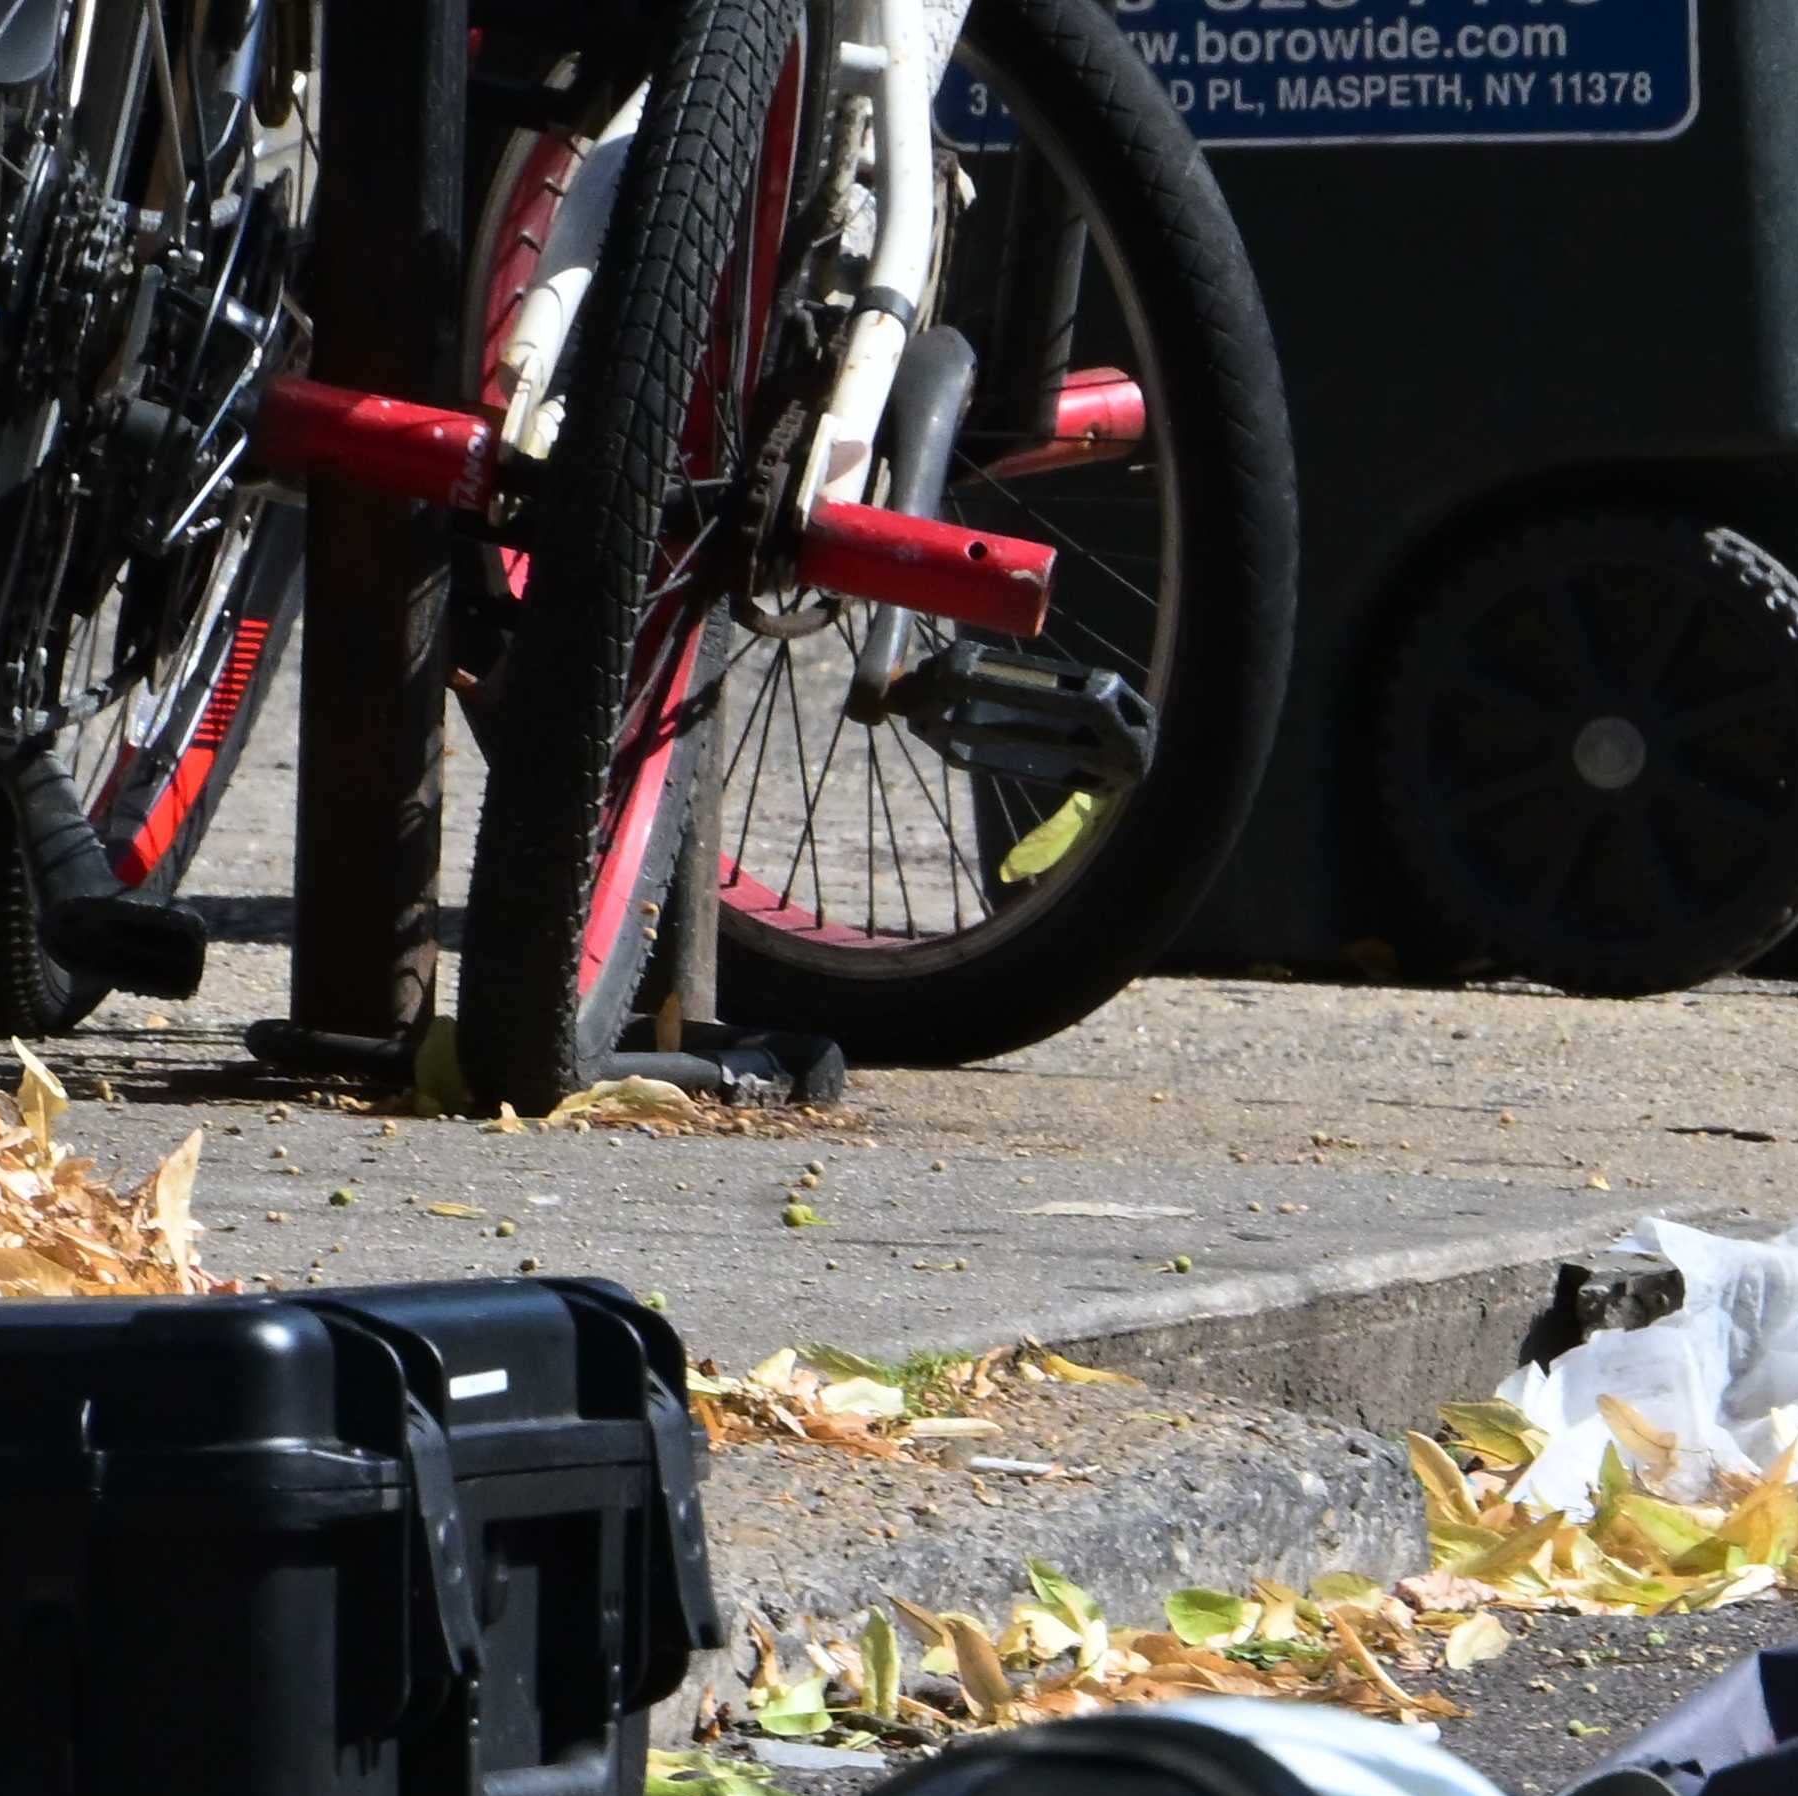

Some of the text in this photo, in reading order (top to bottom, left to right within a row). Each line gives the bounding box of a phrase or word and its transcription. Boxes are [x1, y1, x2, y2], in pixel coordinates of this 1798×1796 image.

[1126, 17, 1567, 63] w.borowide.com
[968, 82, 989, 116] 3
[1207, 78, 1266, 117] PL,
[1276, 72, 1473, 112] MASPETH,
[1485, 71, 1536, 107] NY
[1550, 70, 1652, 105] 11378
